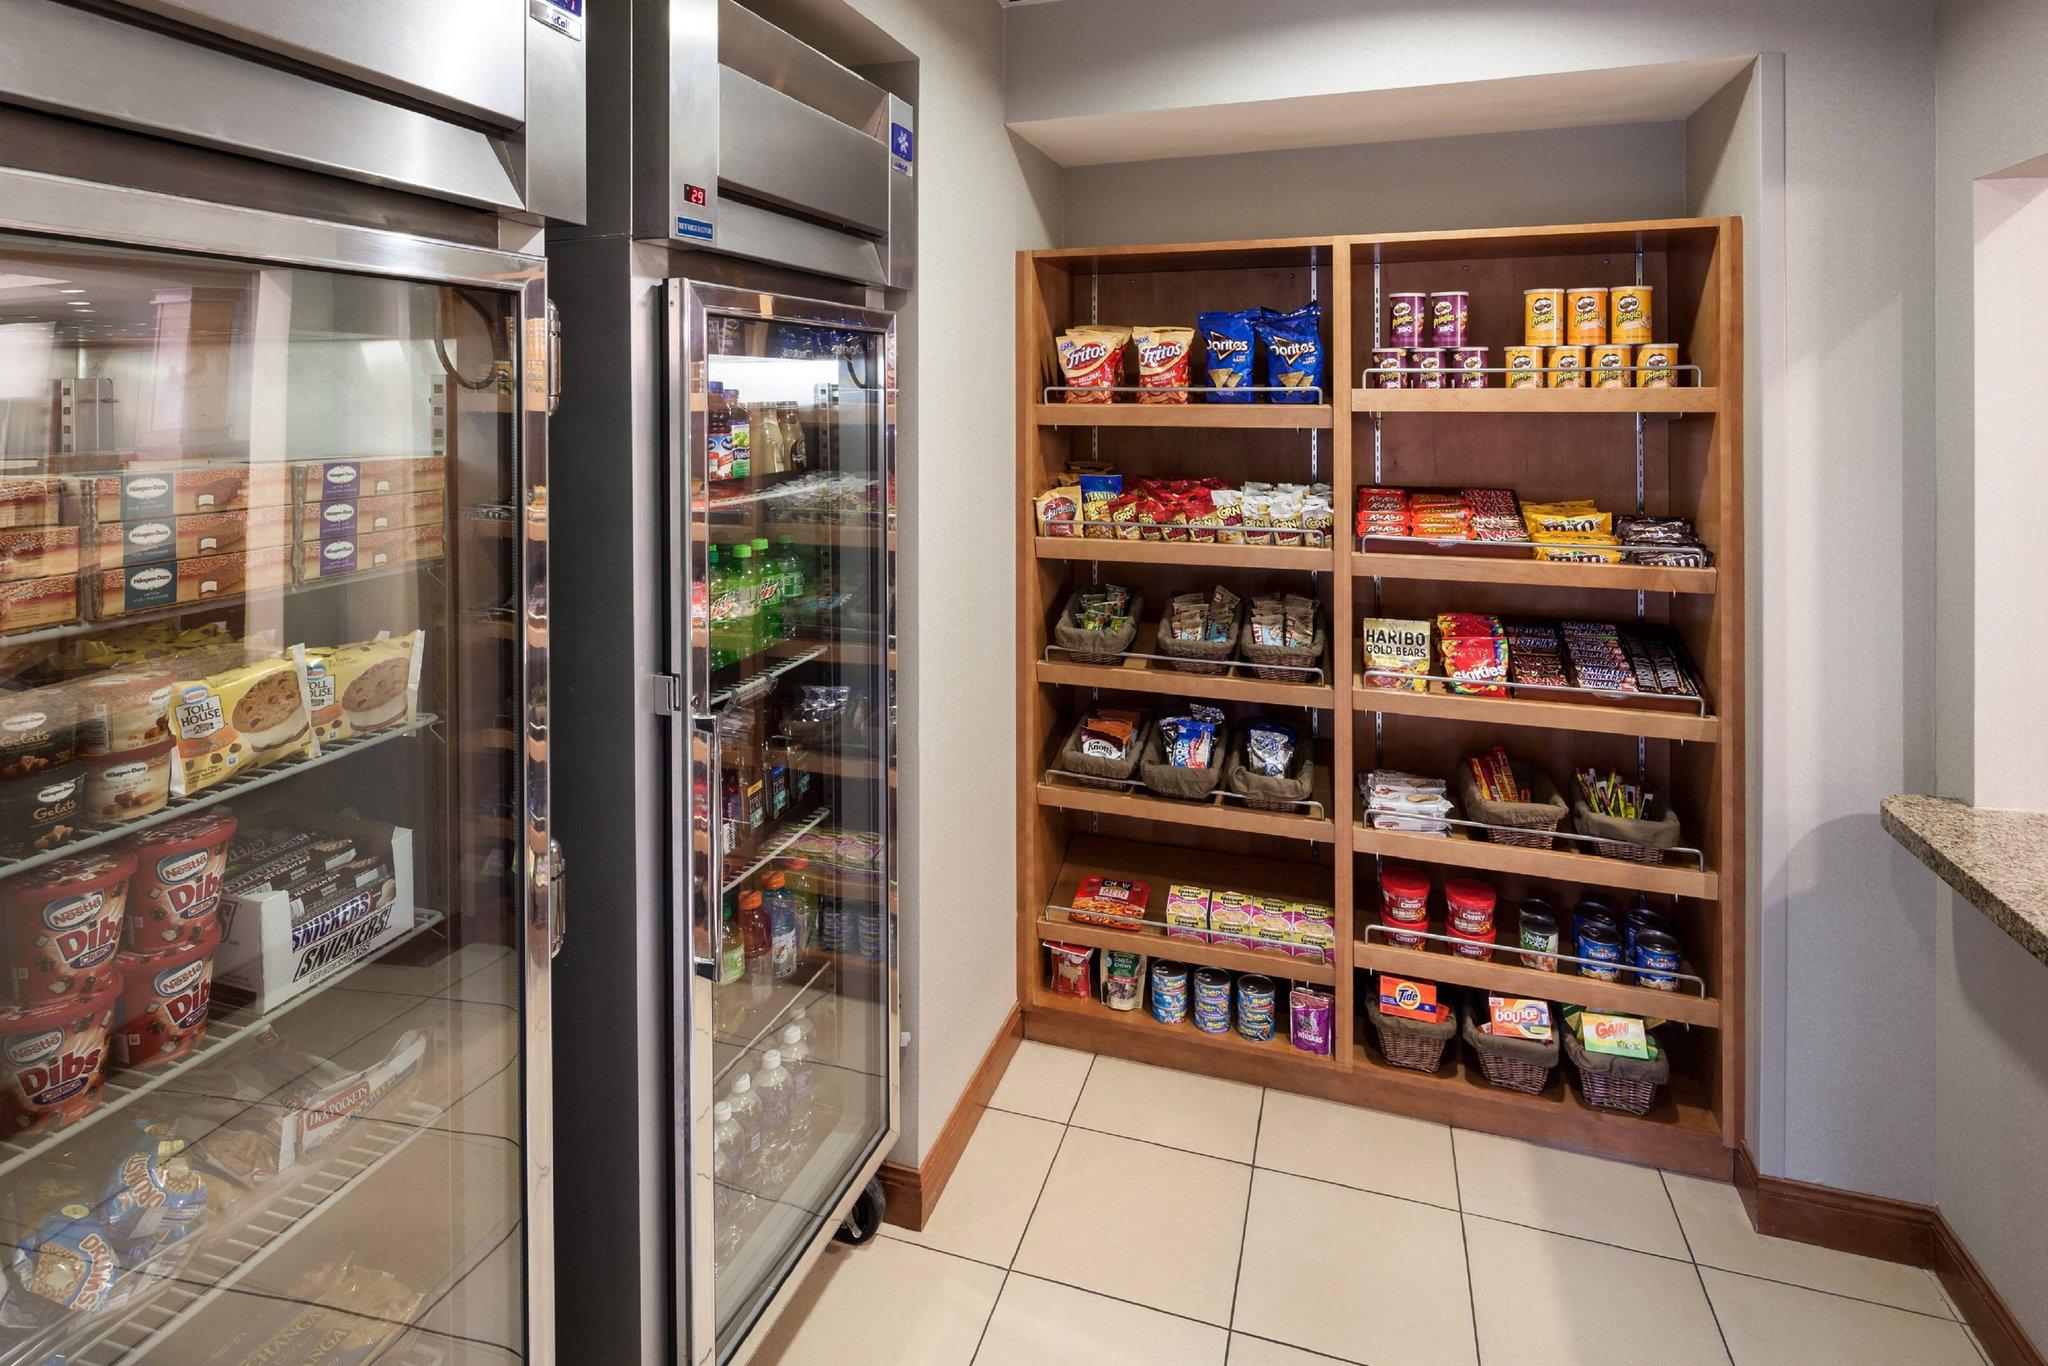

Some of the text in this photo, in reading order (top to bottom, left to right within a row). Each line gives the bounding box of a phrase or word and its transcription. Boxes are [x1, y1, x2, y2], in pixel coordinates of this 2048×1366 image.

[691, 189, 704, 204] 29
[1393, 315, 1414, 330] Pringles
[1434, 314, 1455, 329] Pringles
[1574, 311, 1600, 328] Pringles
[1616, 309, 1643, 327] Pringles
[1067, 345, 1106, 369] Fritos
[1142, 344, 1182, 367] Fritos
[1085, 490, 1119, 502] PLANTERS
[1217, 504, 1241, 520] CORN
[1272, 517, 1298, 530] CORN
[1305, 516, 1331, 529] CORN
[133, 574, 171, 585] Häagen-Dazs
[1253, 622, 1263, 644] CLIF
[1366, 629, 1426, 647] HARIBO
[1451, 660, 1507, 685] Skittles
[1581, 667, 1631, 678] SNICKERS
[184, 701, 214, 718] TOLL
[180, 708, 222, 728] HOUSE
[1087, 741, 1113, 756] Knott's
[105, 766, 147, 779] Häagen-Dazs
[41, 785, 75, 799] Häagen-Dazs
[33, 800, 77, 820] Gelato
[164, 855, 208, 880] Nestlé
[263, 870, 275, 881] ICE
[275, 861, 299, 877] CREAM
[167, 872, 224, 913] Dibs
[304, 878, 327, 894] CREAM
[1104, 880, 1131, 890] CHW
[52, 897, 103, 926] Nestlé
[1261, 902, 1286, 910] Instant
[1302, 907, 1328, 915] Instant
[292, 892, 370, 950] SNICKERS
[1462, 913, 1486, 921] CHUNKY
[55, 917, 123, 963] Dibs
[300, 909, 390, 978] SNICKERS
[1395, 934, 1418, 943] CHUNKY
[1522, 936, 1548, 950] Choice
[1525, 930, 1549, 945] Healthy
[1460, 946, 1484, 956] CHUNKY
[1113, 957, 1132, 965] OMEGA
[1114, 962, 1132, 970] CHEWS
[162, 961, 203, 993] Nestlé
[165, 977, 211, 1024] Dib
[1398, 989, 1419, 1002] Tide
[1495, 1008, 1538, 1024] bounce
[1298, 1031, 1323, 1044] whiskas
[1595, 1022, 1630, 1039] GAIN
[12, 1032, 62, 1061] Nestlé
[18, 1048, 103, 1096] Dibs
[328, 1085, 370, 1117] POCKETS
